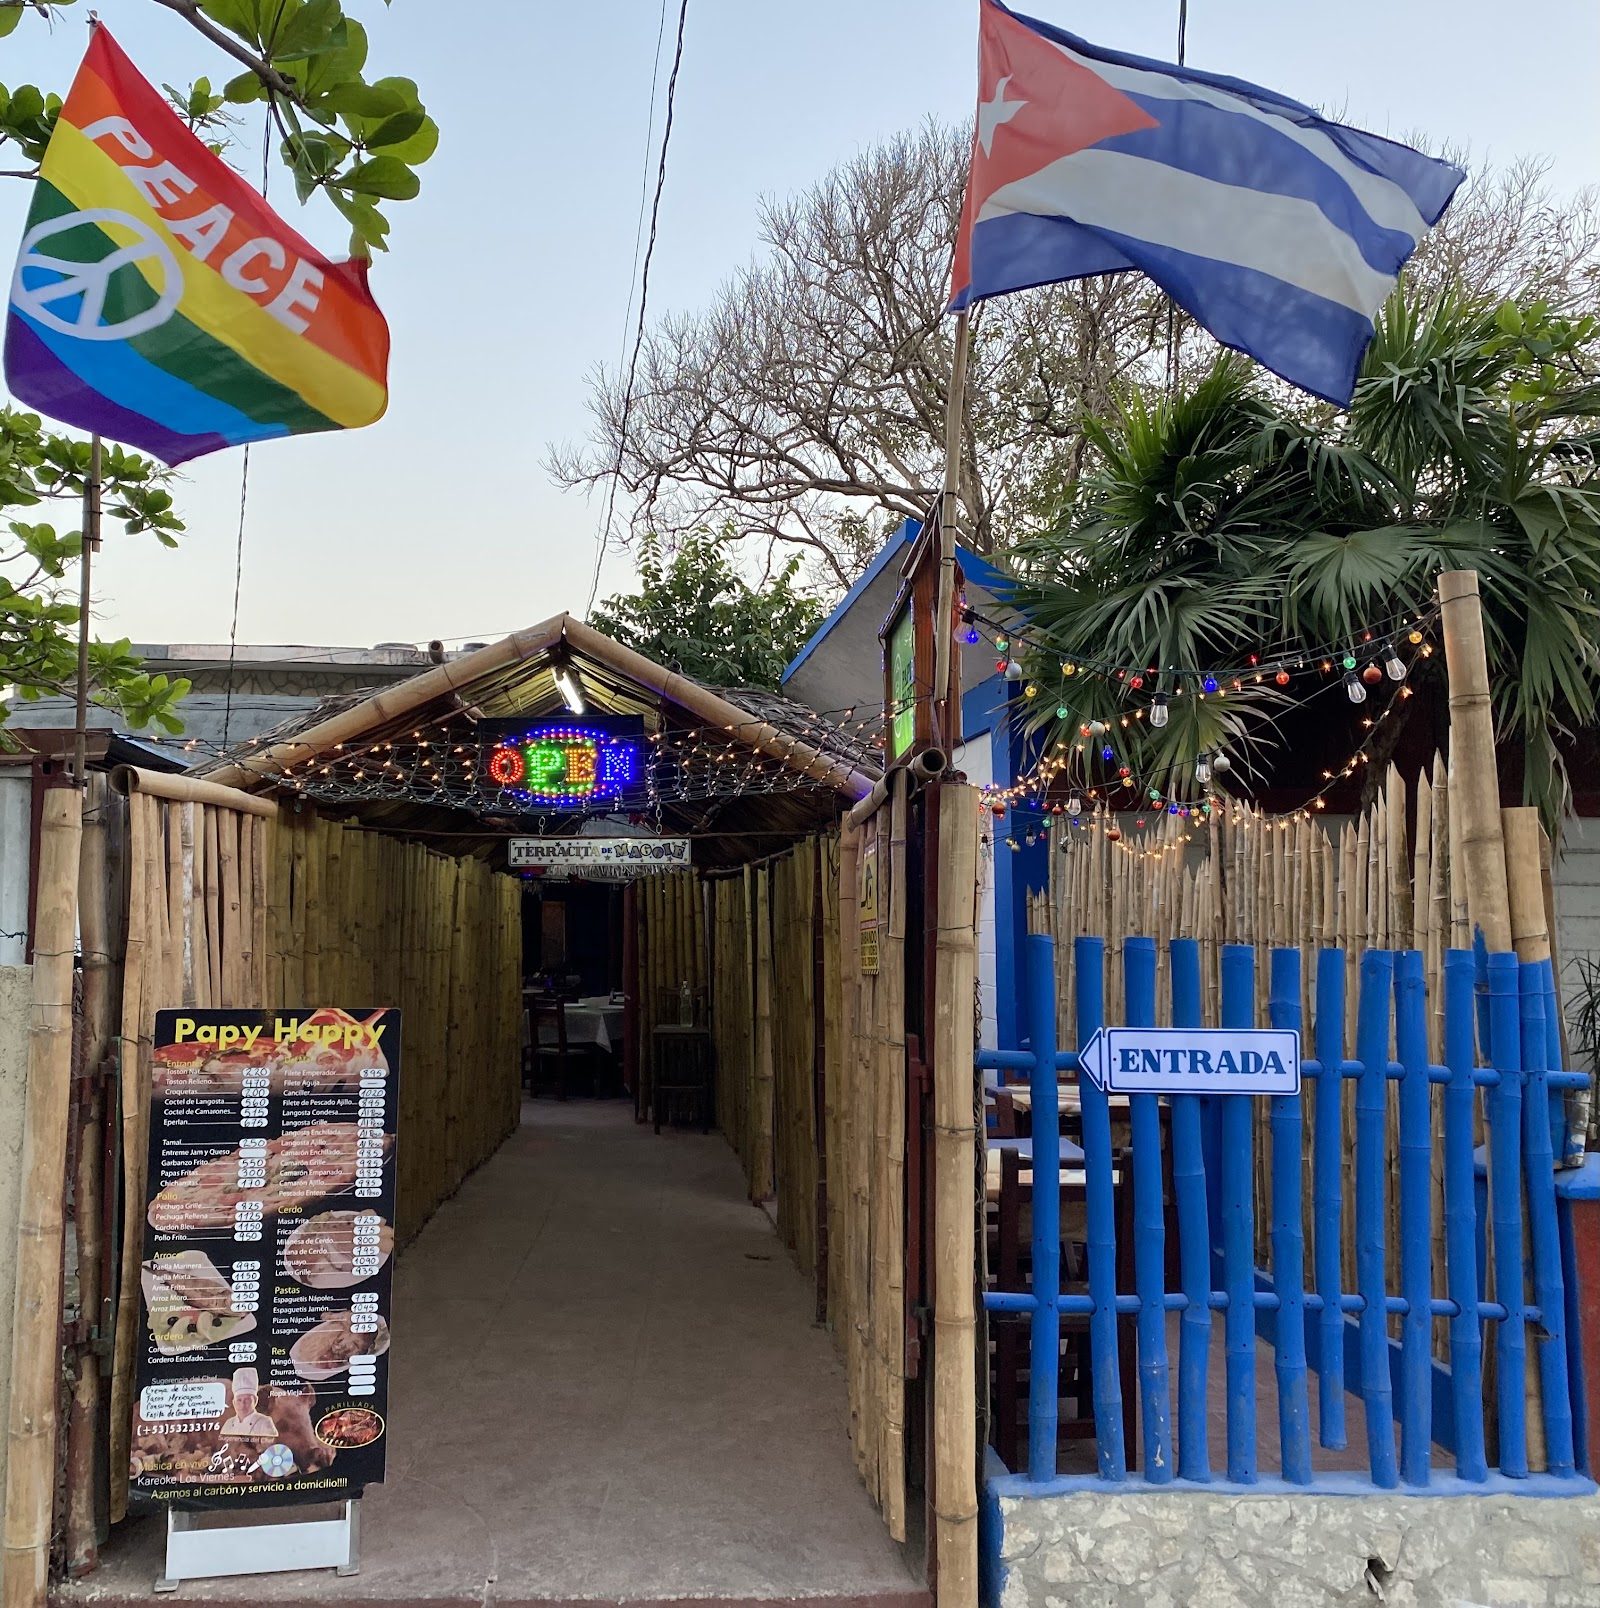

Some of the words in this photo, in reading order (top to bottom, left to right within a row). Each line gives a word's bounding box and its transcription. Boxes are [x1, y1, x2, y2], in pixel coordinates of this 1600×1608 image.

[81, 114, 325, 335] PEACE
[491, 748, 634, 783] OPEN
[515, 846, 600, 857] TERRACITA
[175, 1018, 263, 1051] Papy
[274, 1018, 386, 1050] Happy
[1119, 1049, 1286, 1074] ENTRADA
[246, 1068, 267, 1076] 220
[246, 1079, 266, 1087] 470
[245, 1089, 265, 1097] 200
[360, 1089, 384, 1097] 1020
[244, 1099, 265, 1107] 560
[337, 1099, 352, 1107] Ajillo
[244, 1139, 265, 1147] 250
[278, 1206, 303, 1214] Cerdo
[239, 1233, 257, 1241] 950
[276, 1259, 306, 1267] Uruguayo
[355, 1257, 376, 1265] 1090
[275, 1286, 300, 1295] Pastas
[273, 1296, 307, 1304] Espaguetis
[309, 1295, 334, 1303] Nápoles
[273, 1306, 307, 1314] Espaguetis
[290, 1316, 315, 1324] Nápoles
[149, 1333, 183, 1341] Cordero
[272, 1347, 286, 1355] Res
[325, 1401, 375, 1412] PARILLADA
[137, 1422, 220, 1436] (+53)53233176
[175, 1461, 186, 1469] en
[191, 1460, 208, 1468] vivo
[137, 1476, 176, 1486] Kareoke
[180, 1475, 196, 1483] Los
[200, 1472, 235, 1482] Viernes
[151, 1490, 190, 1499] Azamos
[193, 1487, 201, 1496] al
[204, 1485, 238, 1495] carbón
[240, 1486, 246, 1496] y
[249, 1482, 284, 1493] servicio
[294, 1478, 348, 1490] domicilio!!!!
